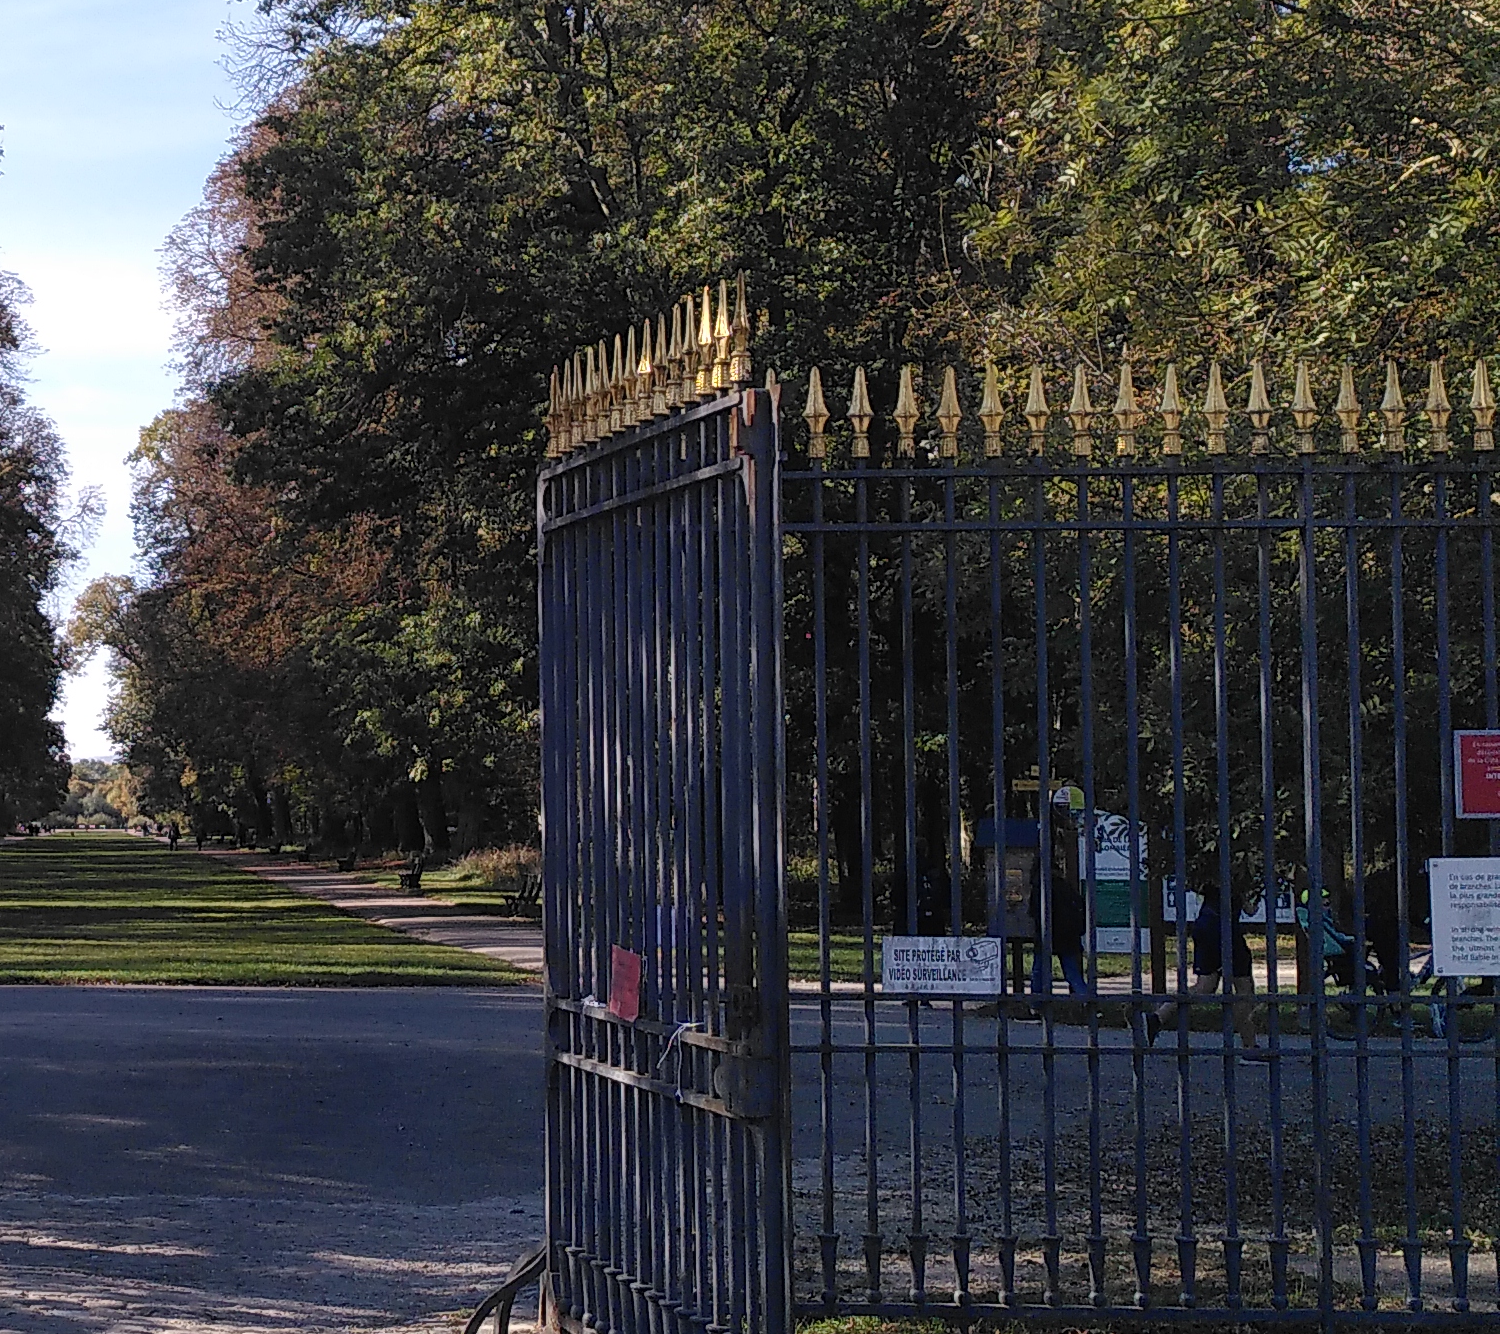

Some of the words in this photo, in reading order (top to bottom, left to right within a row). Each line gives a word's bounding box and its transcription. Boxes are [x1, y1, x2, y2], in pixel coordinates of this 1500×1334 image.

[1459, 892, 1475, 900] plus
[893, 949, 911, 962] SITE
[946, 949, 962, 962] PAR
[912, 968, 967, 982] SURVEILLANCE
